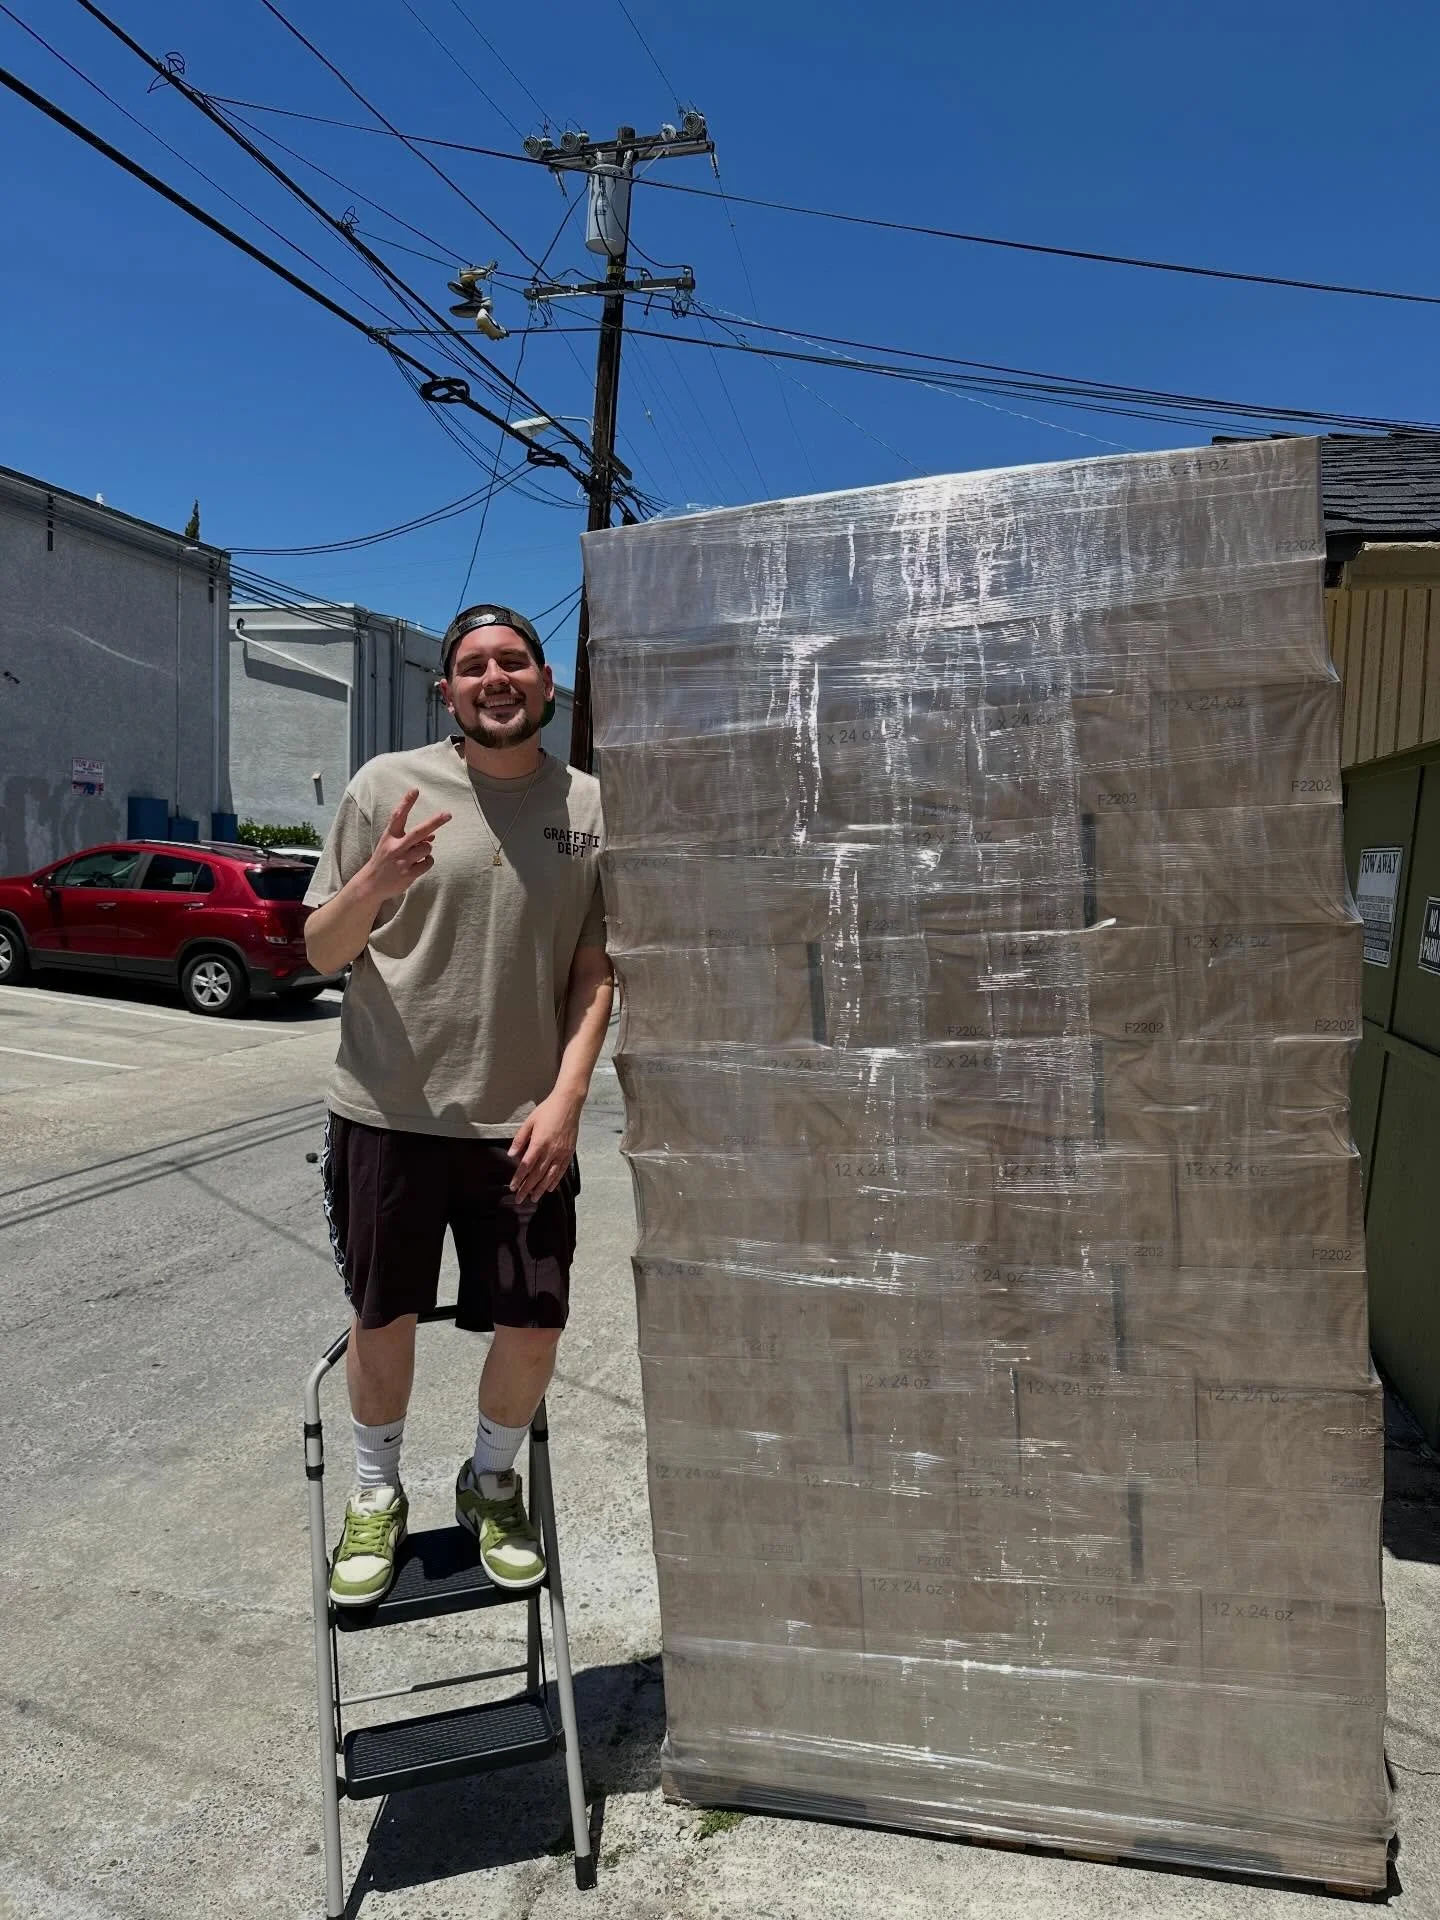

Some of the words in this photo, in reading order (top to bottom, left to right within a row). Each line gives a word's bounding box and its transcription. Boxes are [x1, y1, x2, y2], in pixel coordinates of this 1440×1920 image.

[839, 729, 857, 744] 24
[1291, 779, 1331, 793] F2202
[1097, 792, 1137, 805] F2202
[543, 827, 600, 848] GRAFFITI
[557, 841, 586, 858] DEPT
[1360, 853, 1378, 874] TOW
[1375, 852, 1399, 874] AWAY
[947, 1025, 984, 1038] F2202
[1124, 1022, 1165, 1034] F2202
[1313, 1019, 1355, 1033] F2202
[927, 1054, 943, 1069] 12
[959, 1053, 978, 1069] 24
[834, 1162, 851, 1177] 12
[868, 1162, 887, 1177] 24
[1311, 1247, 1352, 1262] F2202
[982, 1267, 1001, 1283] 24
[891, 1373, 909, 1389] 24
[1027, 1379, 1045, 1396] 12
[870, 1577, 888, 1593] 12
[903, 1578, 921, 1593] 24
[1071, 1590, 1089, 1604] 24
[1209, 1600, 1231, 1617] 12
[1248, 1603, 1270, 1619] 24
